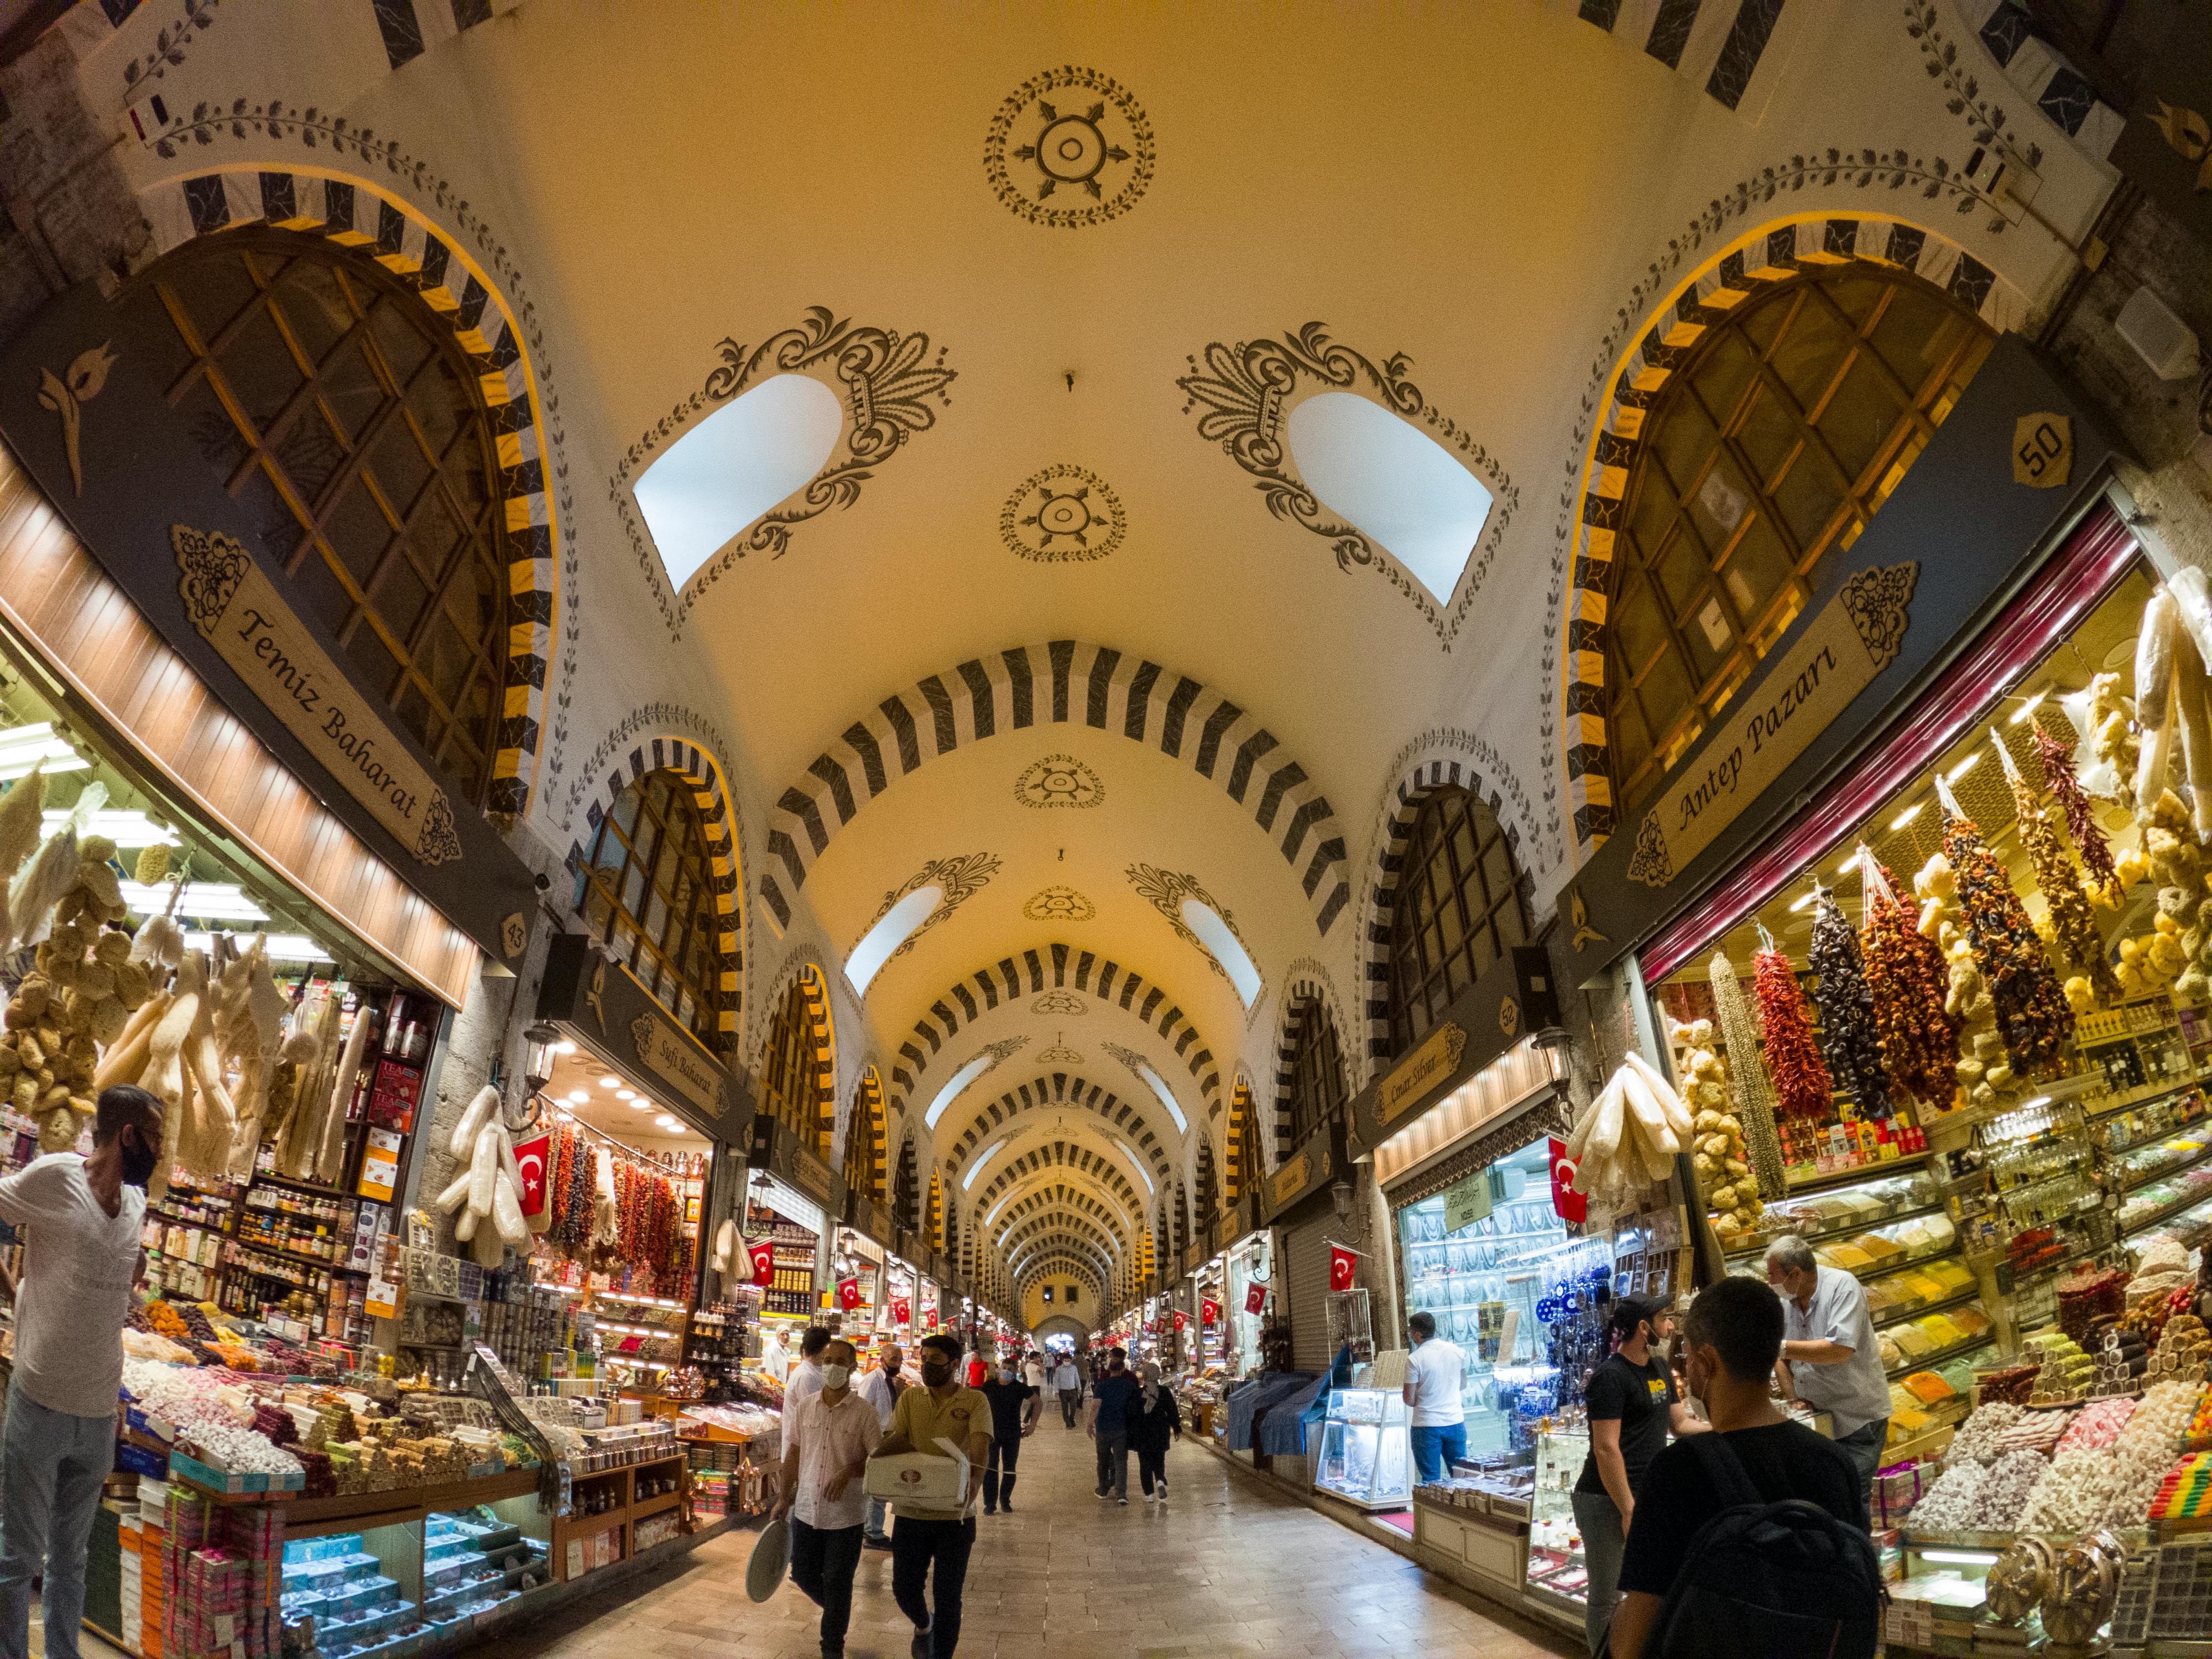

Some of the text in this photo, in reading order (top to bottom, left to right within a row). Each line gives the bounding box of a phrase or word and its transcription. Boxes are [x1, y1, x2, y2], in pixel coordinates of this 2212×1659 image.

[2019, 422, 2063, 477] 50
[238, 609, 417, 819] Temiz Baharat
[1679, 645, 1837, 832] Antep Pazarı
[1502, 1004, 1514, 1027] 52
[383, 1061, 403, 1074] TEA
[679, 1057, 711, 1094] Baharat
[1413, 1054, 1436, 1086] Silver
[376, 1094, 394, 1107] TEA
